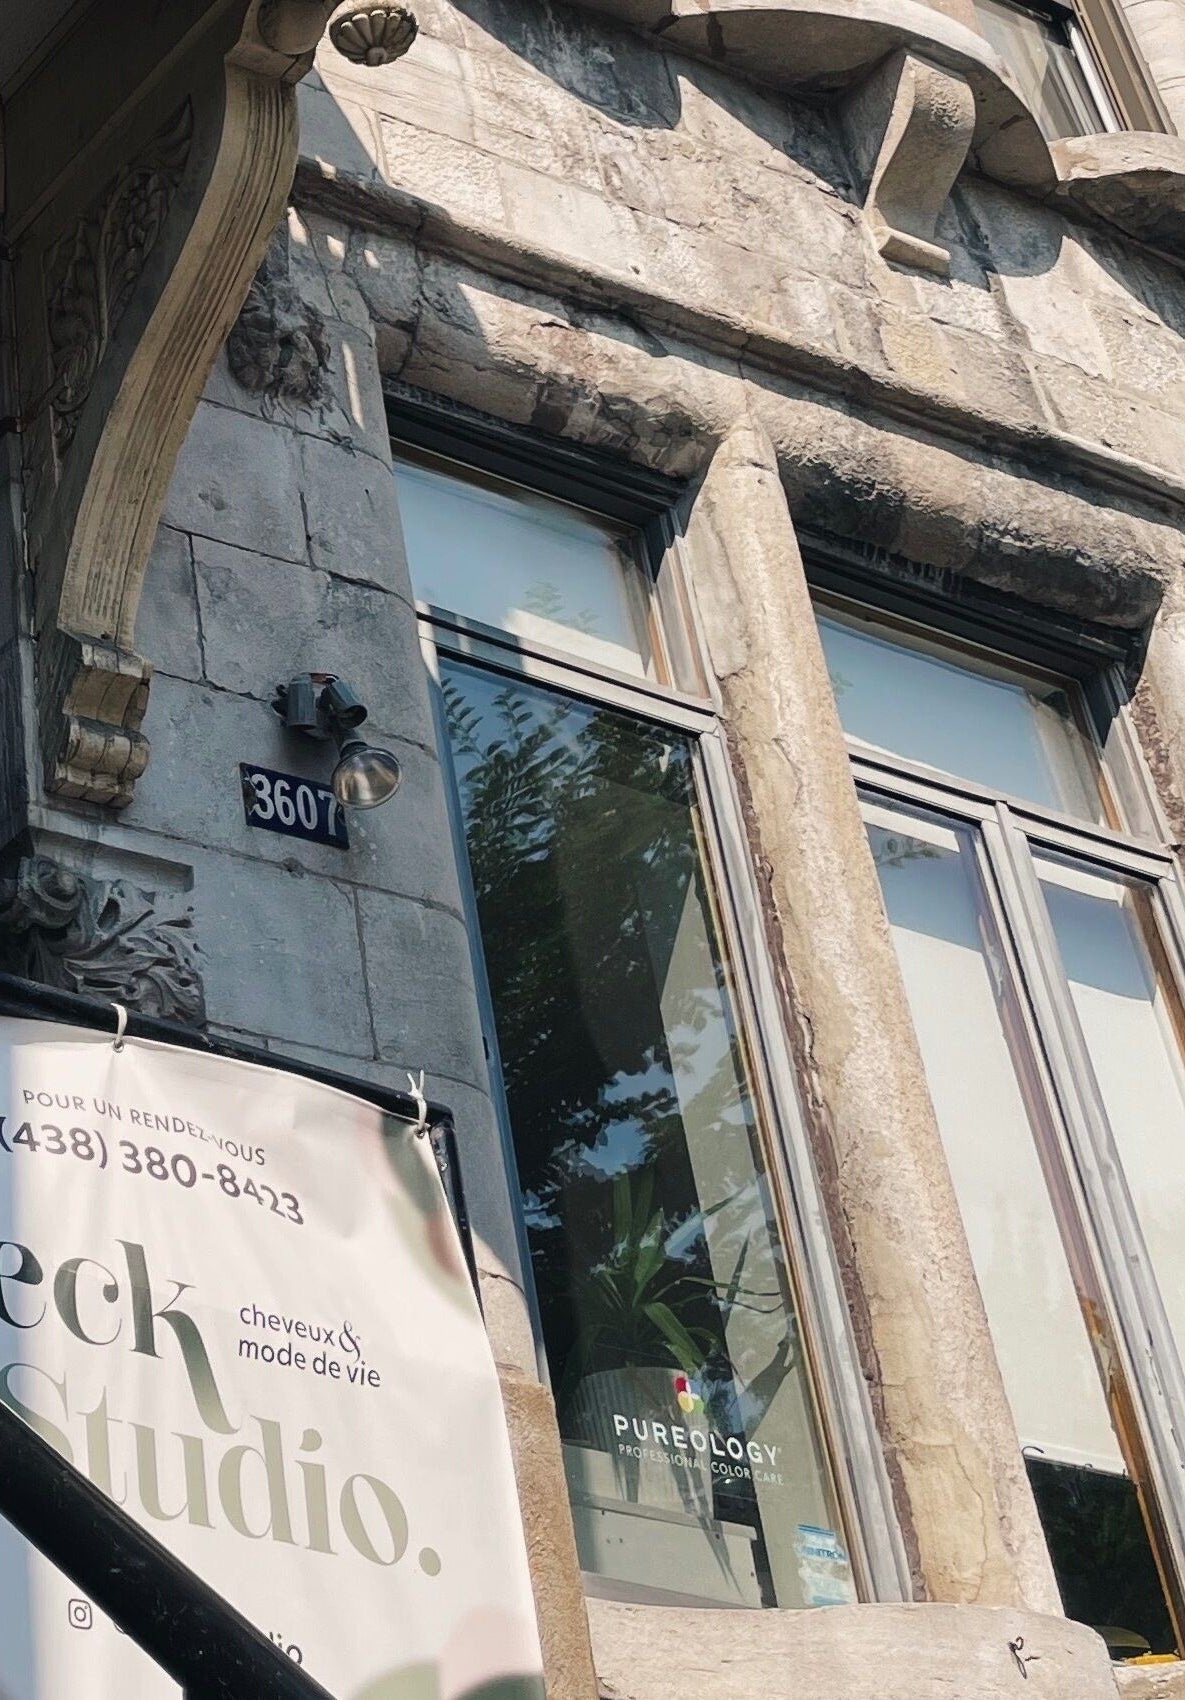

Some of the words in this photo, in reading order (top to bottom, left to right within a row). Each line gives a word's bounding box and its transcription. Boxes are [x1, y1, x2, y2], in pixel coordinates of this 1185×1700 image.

[251, 773, 337, 836] 3607
[23, 1089, 87, 1111] POUR
[93, 1098, 122, 1121] UN
[130, 1108, 265, 1166] RENDEZ-VOUS
[119, 1140, 304, 1226] 380-8423
[238, 1338, 307, 1371] mode
[312, 1351, 341, 1380] de
[347, 1361, 381, 1388] vie
[239, 1303, 336, 1347] cheveux
[338, 1320, 361, 1363] &
[613, 1414, 778, 1467] PUREOLOGY
[618, 1443, 708, 1472] PROFESSIONAL
[710, 1461, 752, 1479] COLOR
[754, 1469, 785, 1486] CARE
